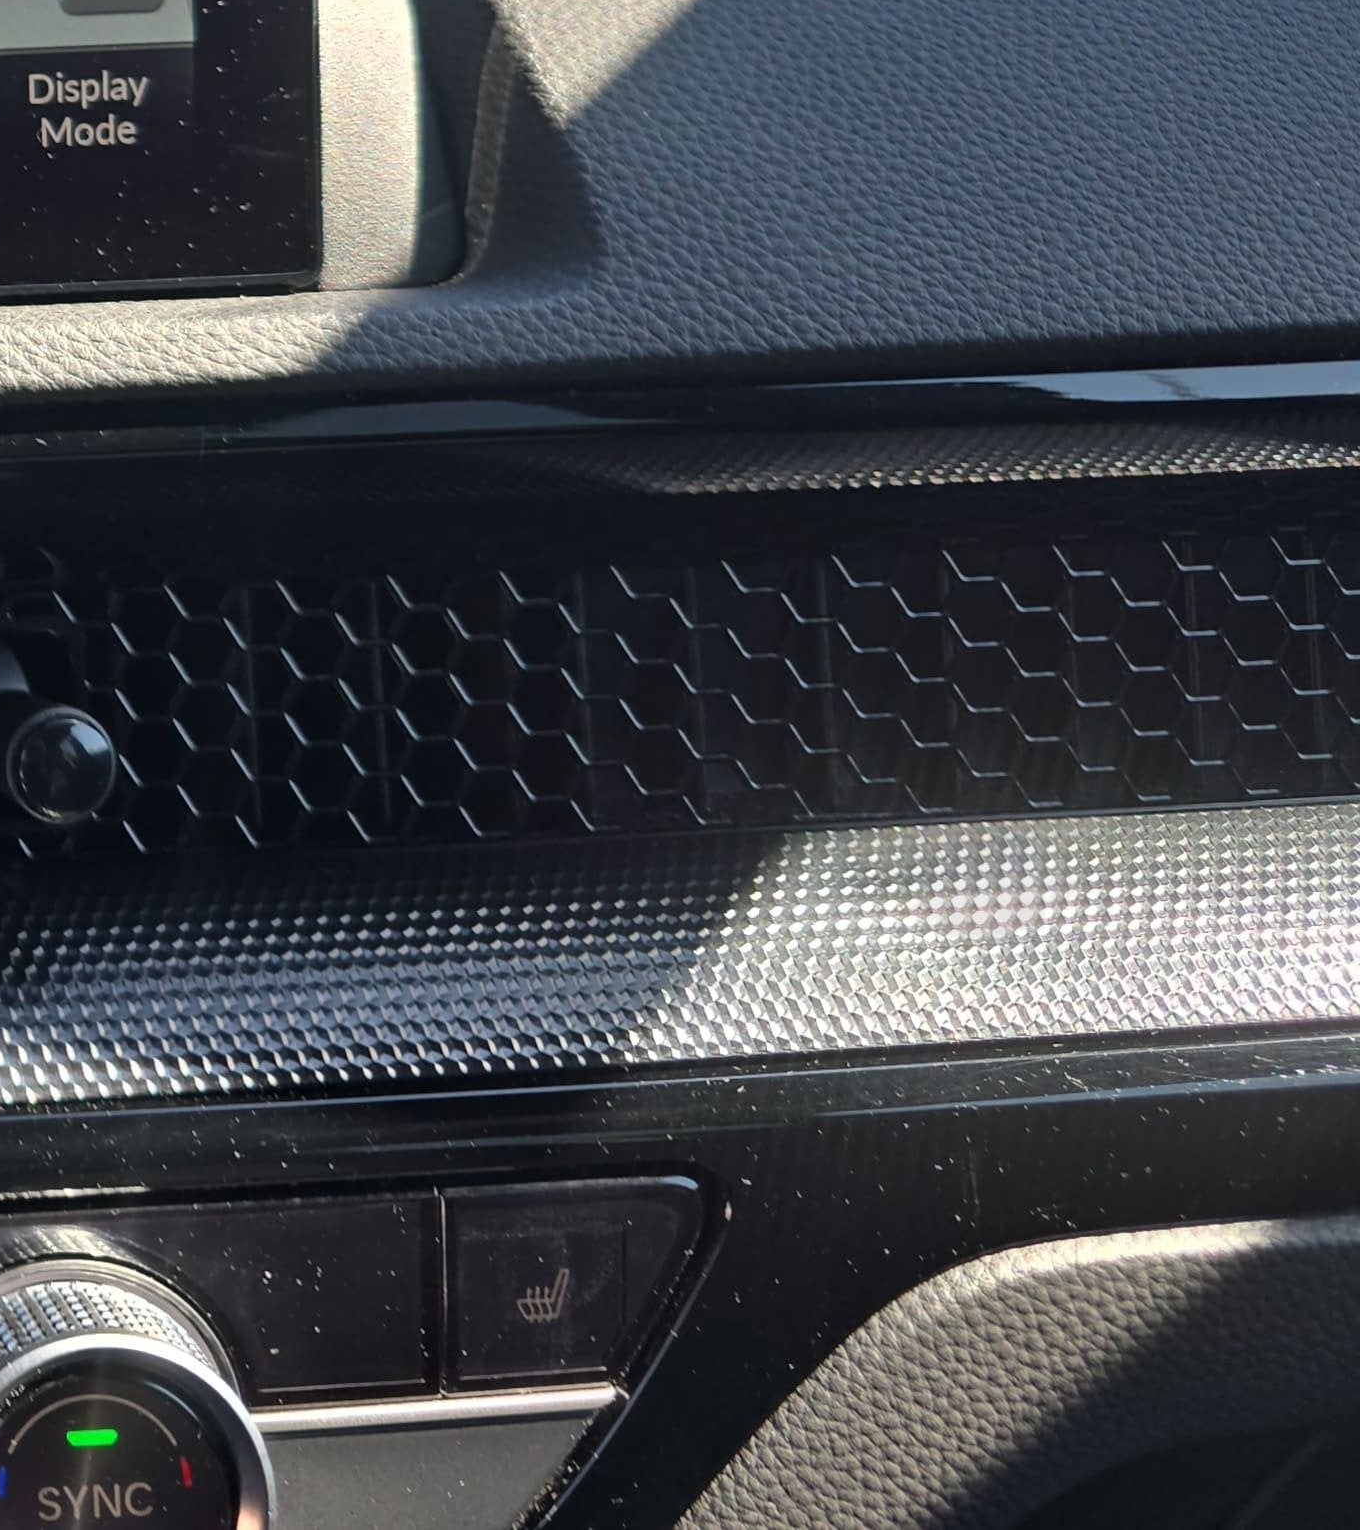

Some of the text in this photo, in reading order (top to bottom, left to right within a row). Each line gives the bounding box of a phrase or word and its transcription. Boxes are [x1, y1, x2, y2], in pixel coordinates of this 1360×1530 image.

[28, 69, 149, 110] Display
[40, 113, 137, 148] Mode
[38, 1481, 154, 1521] SYNC
